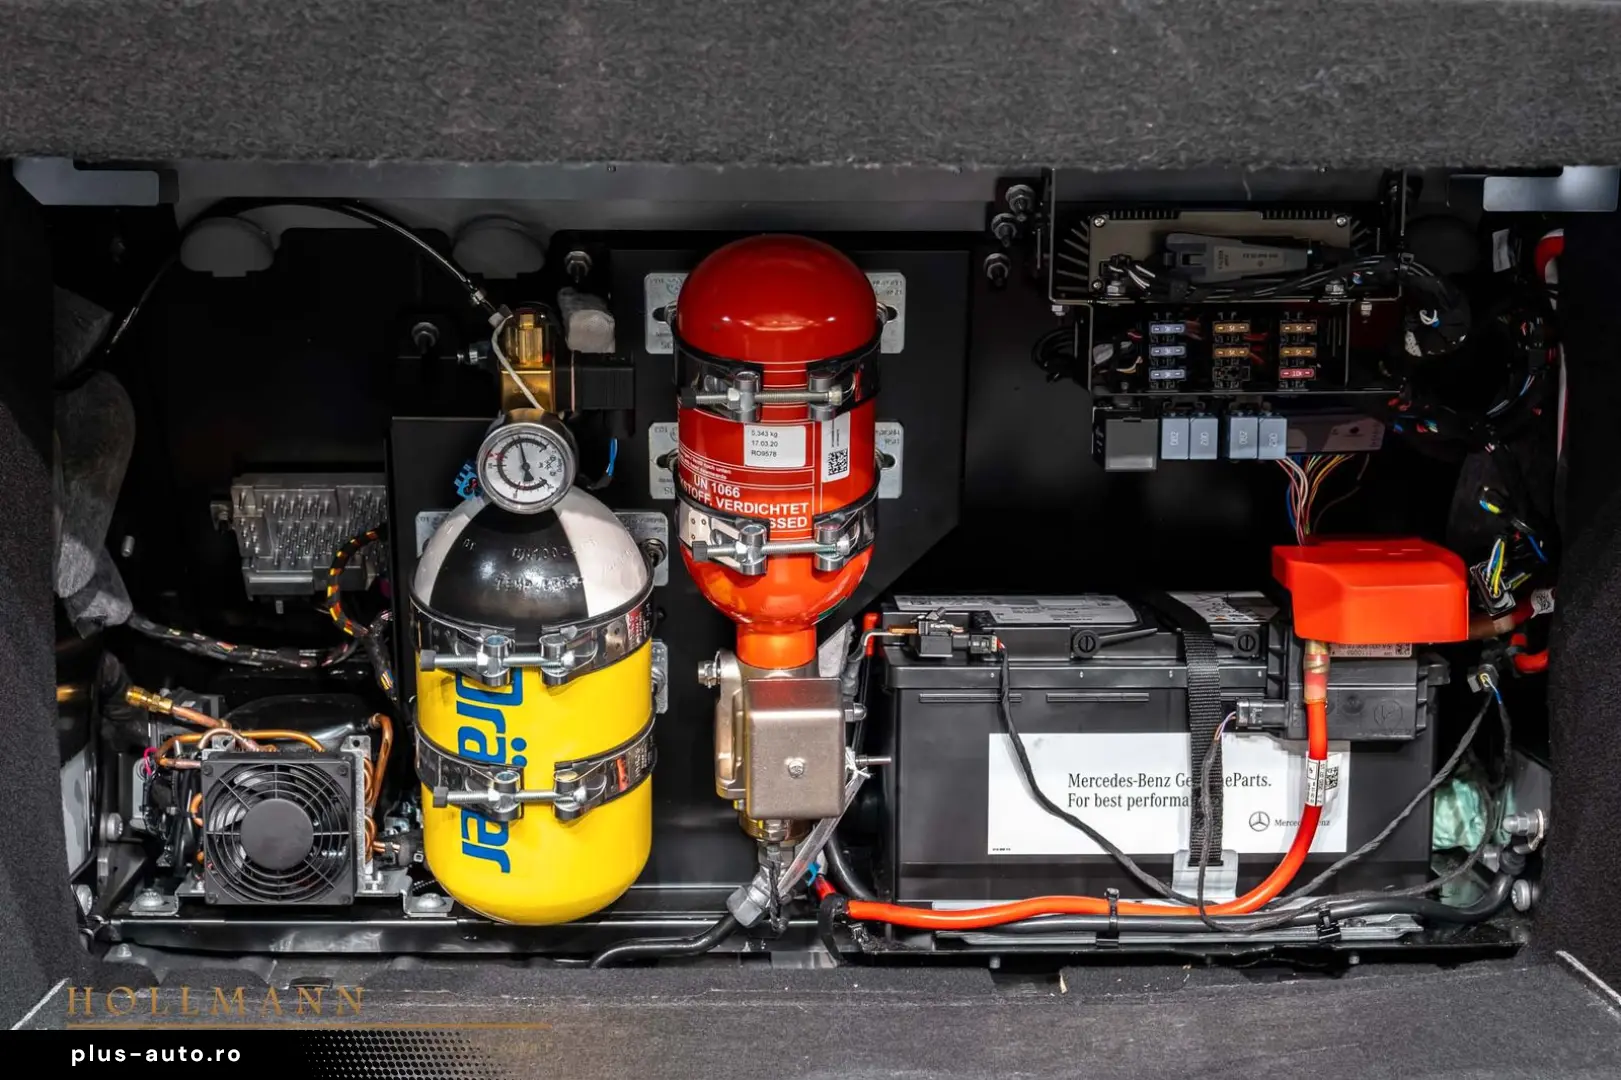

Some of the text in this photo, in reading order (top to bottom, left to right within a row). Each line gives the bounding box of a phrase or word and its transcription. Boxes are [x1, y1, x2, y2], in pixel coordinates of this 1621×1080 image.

[693, 474, 708, 491] UN
[711, 482, 741, 499] 1066
[716, 498, 809, 515] VERDICHTET
[769, 516, 808, 529] SSED
[455, 667, 528, 874] Dräer
[1067, 772, 1272, 788] Mercedes-Benz GeeParts.
[1067, 793, 1191, 812] For best performa
